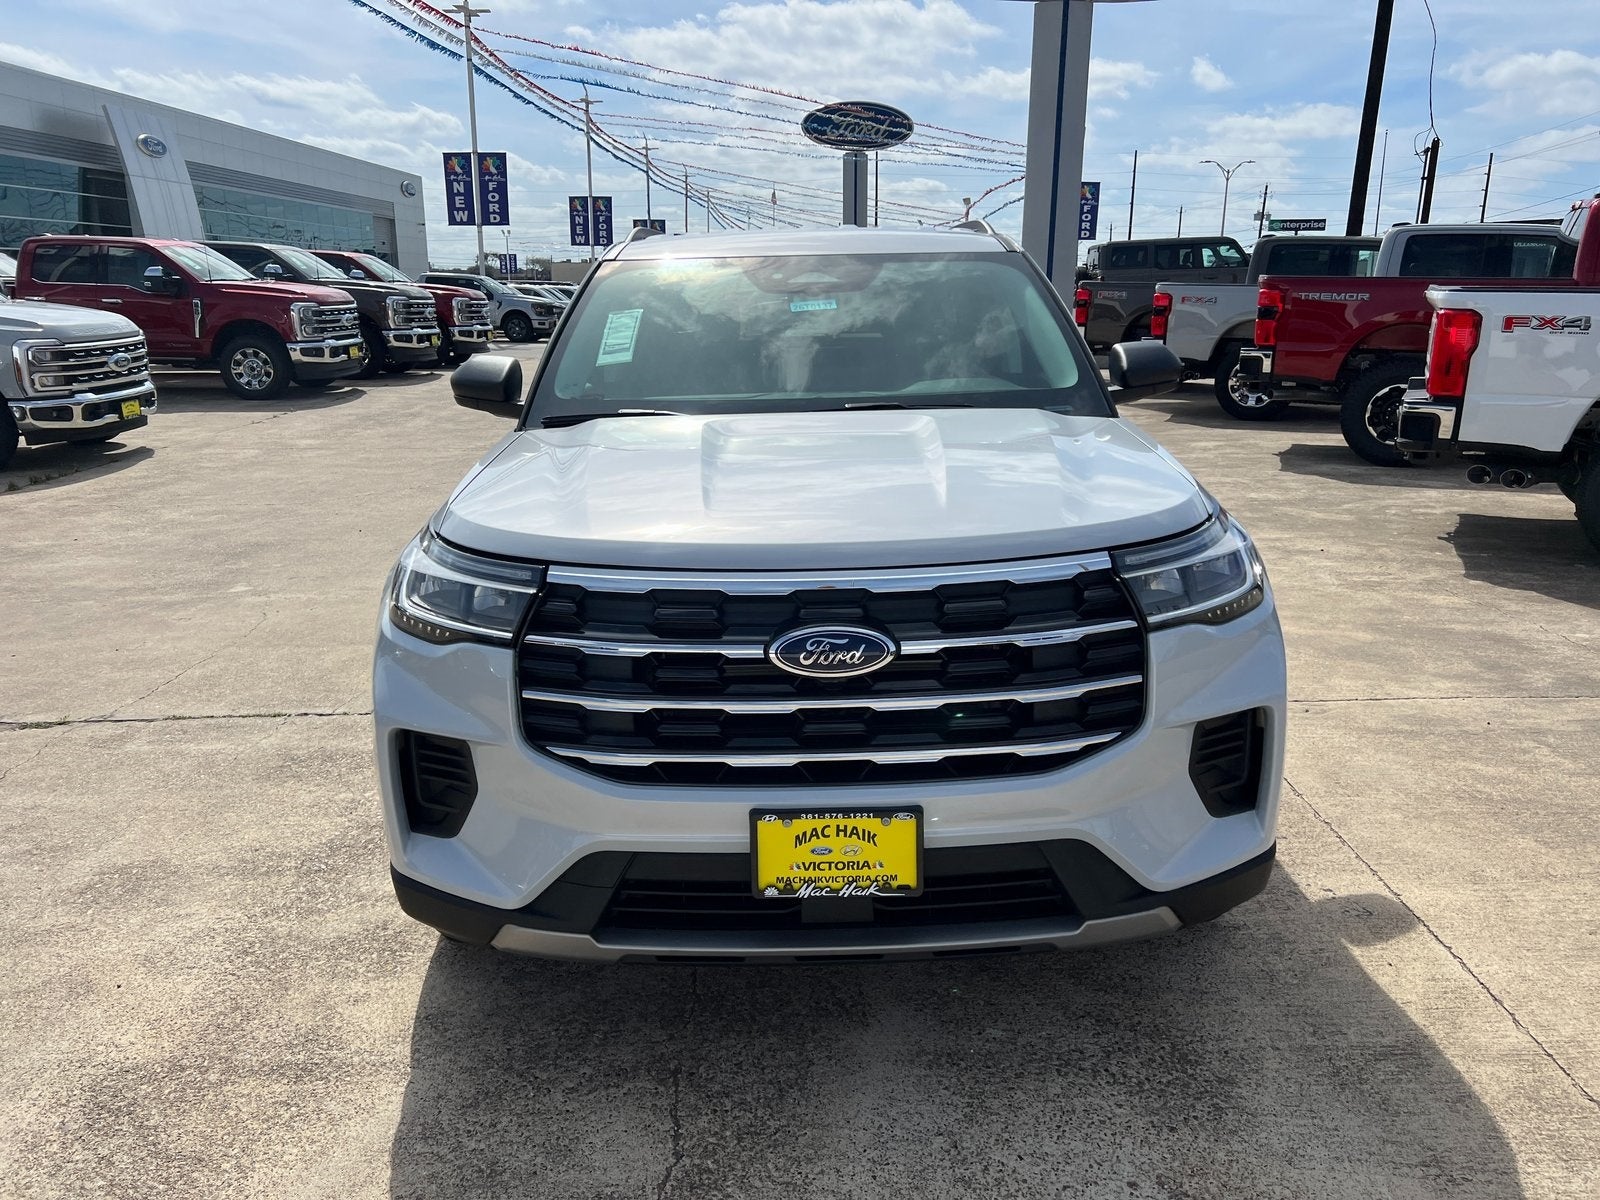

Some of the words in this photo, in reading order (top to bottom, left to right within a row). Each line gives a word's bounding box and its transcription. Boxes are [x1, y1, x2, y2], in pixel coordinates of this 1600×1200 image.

[453, 181, 468, 222] NEW
[488, 181, 501, 223] FORD
[574, 215, 586, 244] NEW
[598, 216, 608, 245] FORD
[1081, 204, 1092, 238] FORD
[1271, 220, 1325, 230] enterprise
[1181, 296, 1218, 304] FX4
[1298, 292, 1370, 301] TREMOR
[1501, 314, 1592, 333] FX4
[799, 637, 866, 666] Ford
[800, 812, 875, 820] 361-576-1221
[794, 824, 831, 849] MAC
[835, 824, 878, 848] HAIK
[801, 860, 872, 872] VICTORIA
[776, 874, 898, 884] MACHAIKVICTORIA.COM
[796, 882, 836, 898] Mac
[838, 881, 890, 898] Haik
